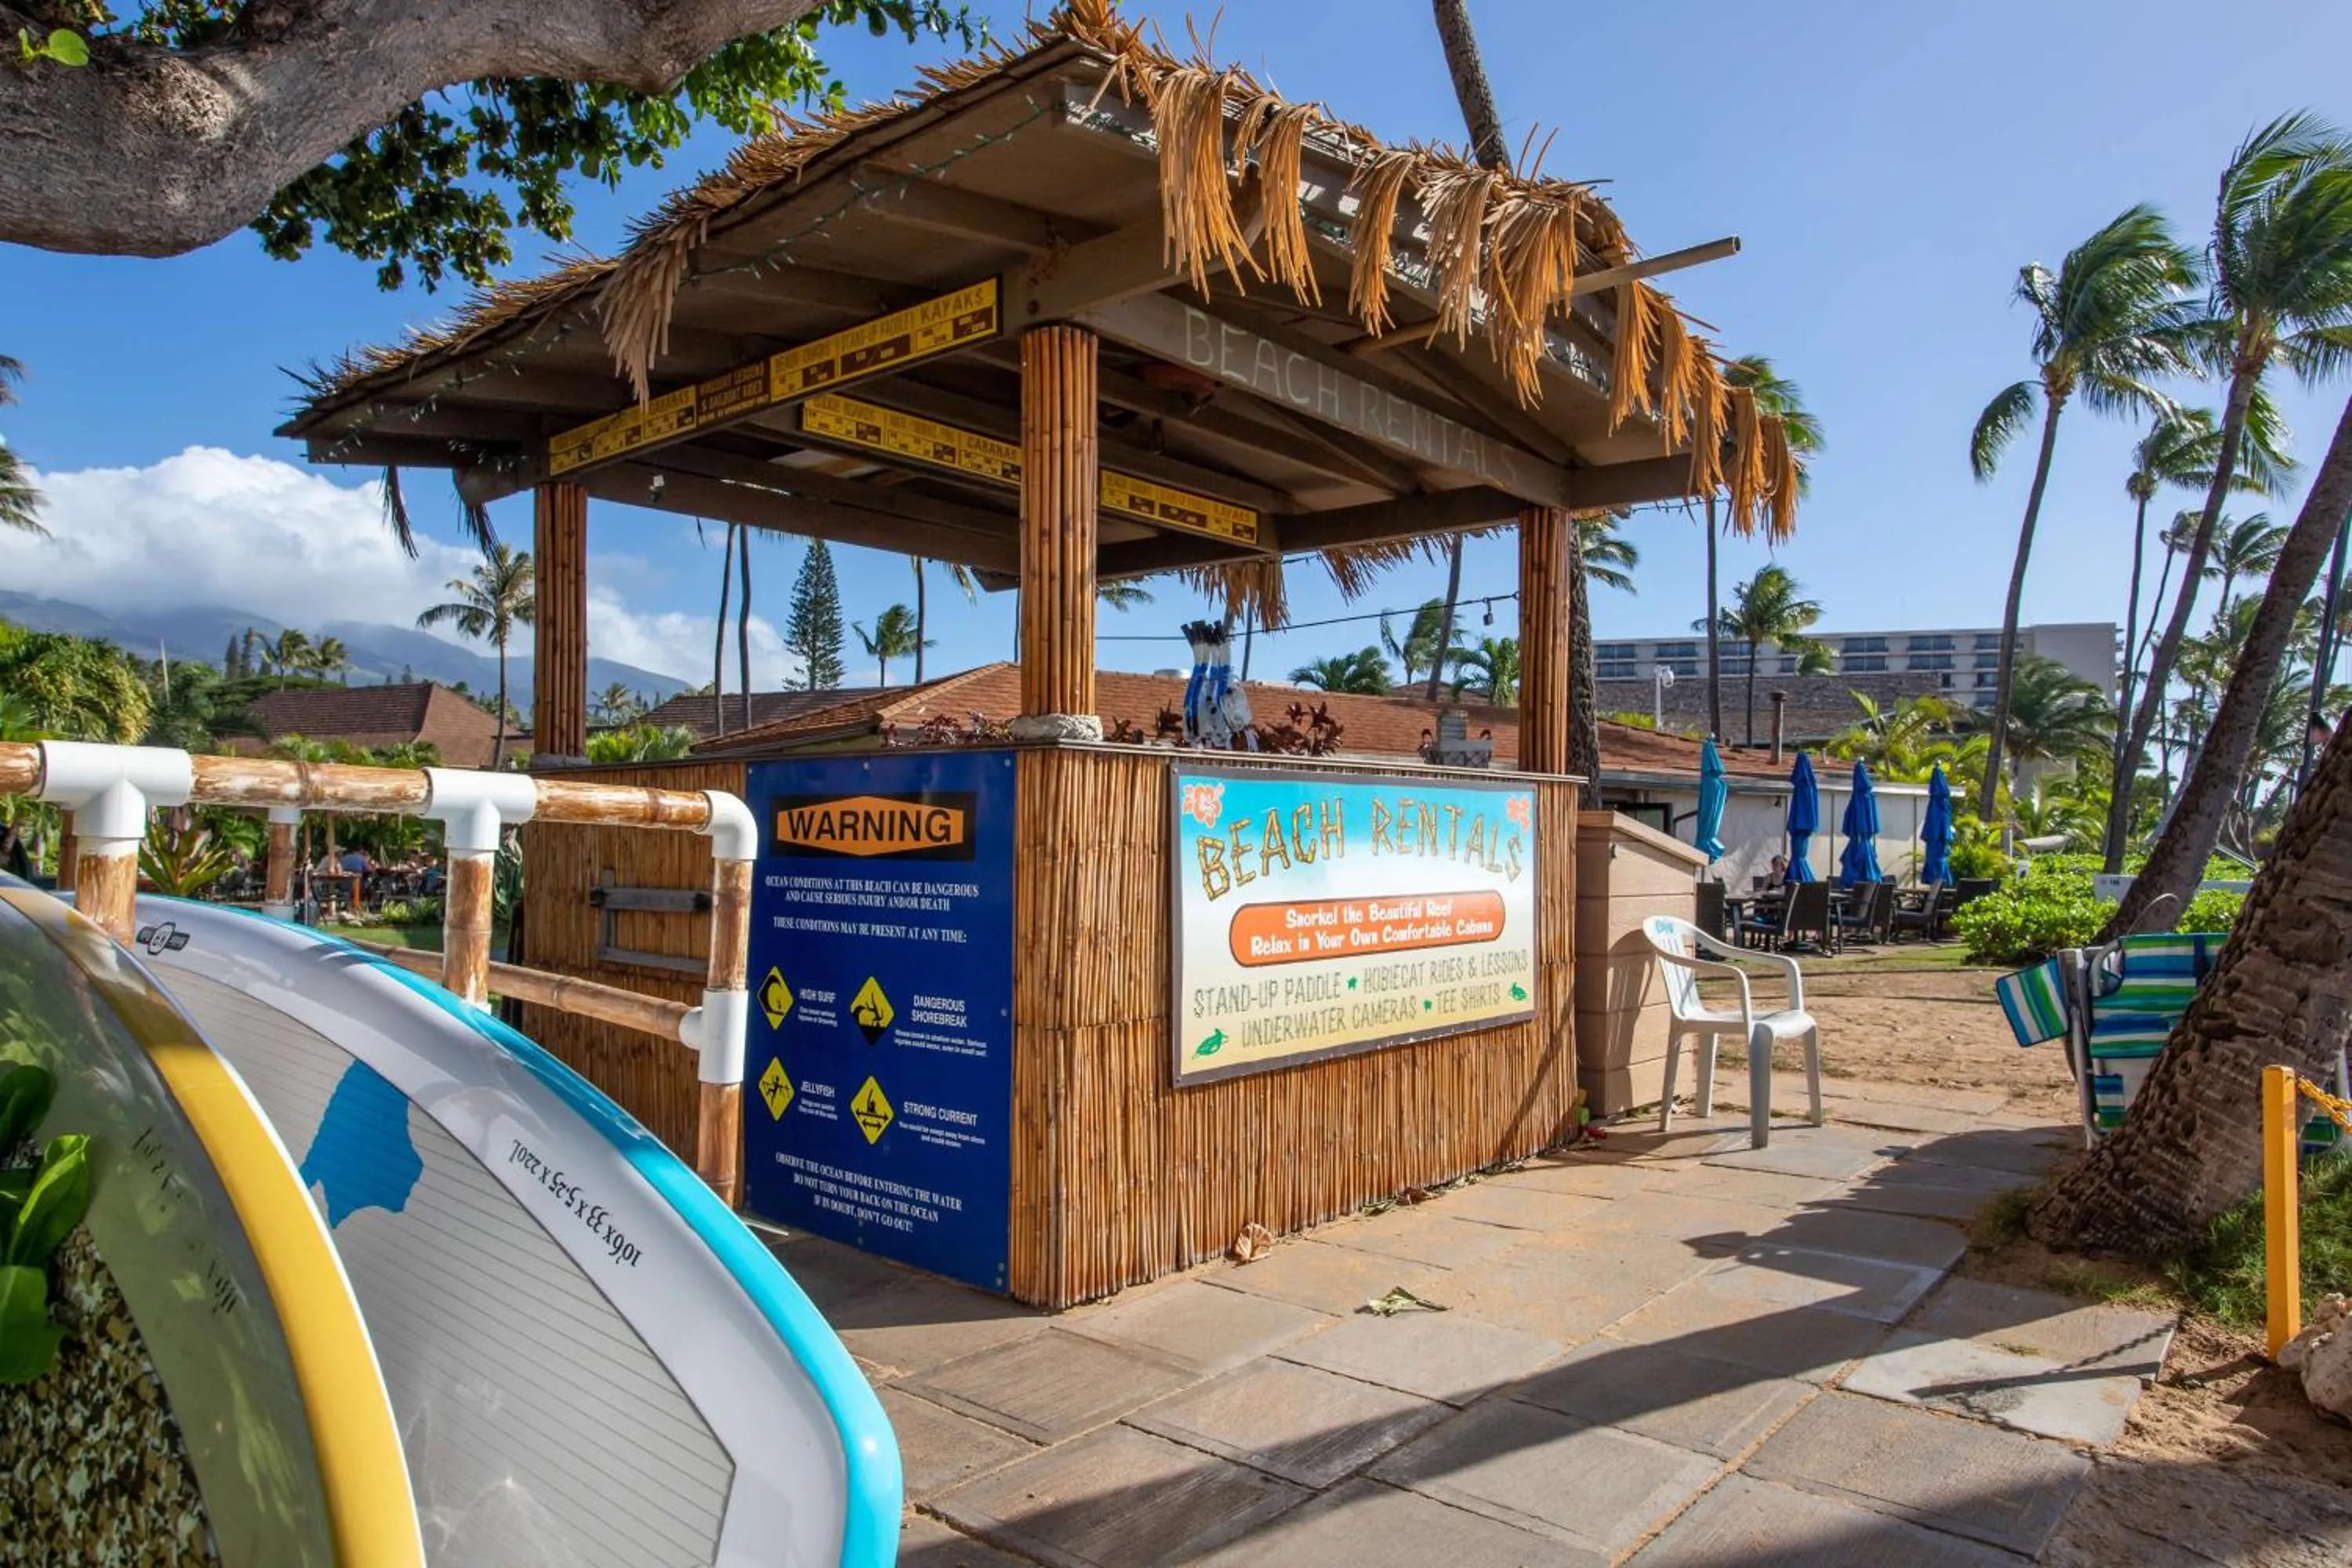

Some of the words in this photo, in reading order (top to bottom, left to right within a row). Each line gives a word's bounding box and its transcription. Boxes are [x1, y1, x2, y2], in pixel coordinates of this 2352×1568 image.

[1184, 305, 1341, 421] BEACH
[787, 808, 952, 842] WARNING
[1197, 798, 1345, 901] BEACH
[1371, 798, 1523, 882] RENTALS
[765, 875, 788, 887] OCEAN
[789, 877, 833, 890] CONDITIONS
[834, 878, 845, 891] AT
[845, 879, 863, 891] THIS
[865, 880, 891, 893] BEACH
[892, 880, 910, 894] CAN
[912, 882, 923, 895] BE
[924, 882, 979, 898] DANGEROUS
[785, 890, 800, 902] AND
[800, 891, 823, 904] CAUSE
[824, 892, 857, 906] SERIOUS
[857, 894, 886, 907] INJURY
[920, 898, 950, 911] DEATH
[773, 916, 794, 929] THESE
[795, 918, 840, 933] CONDITIONS
[840, 921, 858, 935] MAY
[858, 923, 869, 935] BE
[870, 924, 907, 938] PRESENT
[907, 927, 919, 940] AT
[920, 927, 939, 941] ANY
[941, 929, 967, 943] TIME:
[1286, 906, 1338, 928] Snorkel
[1343, 905, 1363, 924] the
[1369, 901, 1421, 922] Beautiful
[1426, 898, 1454, 917] Reef
[1250, 934, 1293, 957] Relax
[1298, 931, 1310, 952] in
[1315, 930, 1345, 950] Your
[1350, 927, 1378, 946] Own
[1382, 920, 1452, 943] Comfortable
[1456, 918, 1494, 935] Cabana
[1193, 979, 1279, 1018] STAND-UP
[1285, 971, 1341, 1006] PADDLE
[1363, 962, 1425, 994] HOBIECAT
[1429, 956, 1464, 985] RIDES
[1468, 956, 1478, 979] &
[1481, 949, 1529, 978] LESSONS
[911, 1009, 967, 1028] SHOREBREAK
[913, 994, 965, 1012] DANGEROUS
[1242, 1007, 1347, 1048] UNDERWATER
[1351, 995, 1417, 1029] CAMERAS
[1436, 989, 1457, 1014] TEE
[1461, 982, 1501, 1011] SHIRTS
[800, 1080, 834, 1098] JELLYFISH
[903, 1101, 936, 1119] STRONG
[938, 1108, 978, 1127] CURRENT
[509, 1139, 542, 1175] 220L
[548, 1171, 583, 1208] 5.25
[775, 1152, 805, 1170] OBSERVE
[805, 1160, 819, 1174] THE
[819, 1163, 844, 1180] OCEAN
[844, 1171, 873, 1189] BEFORE
[874, 1178, 913, 1199] ENTERING
[914, 1188, 931, 1203] THE
[931, 1192, 962, 1211] WATER
[793, 1173, 804, 1185] DO
[804, 1176, 818, 1189] NOT
[819, 1180, 838, 1196] TURN
[838, 1185, 858, 1201] YOUR
[860, 1191, 880, 1207] BACK
[880, 1197, 893, 1210] ON
[894, 1200, 910, 1215] THE
[910, 1205, 938, 1223] OCEAN
[586, 1205, 609, 1233] 33
[814, 1194, 822, 1205] IF
[822, 1196, 830, 1208] IN
[830, 1199, 857, 1218] DOUBT,
[857, 1207, 880, 1224] DON'T
[880, 1214, 893, 1227] GO
